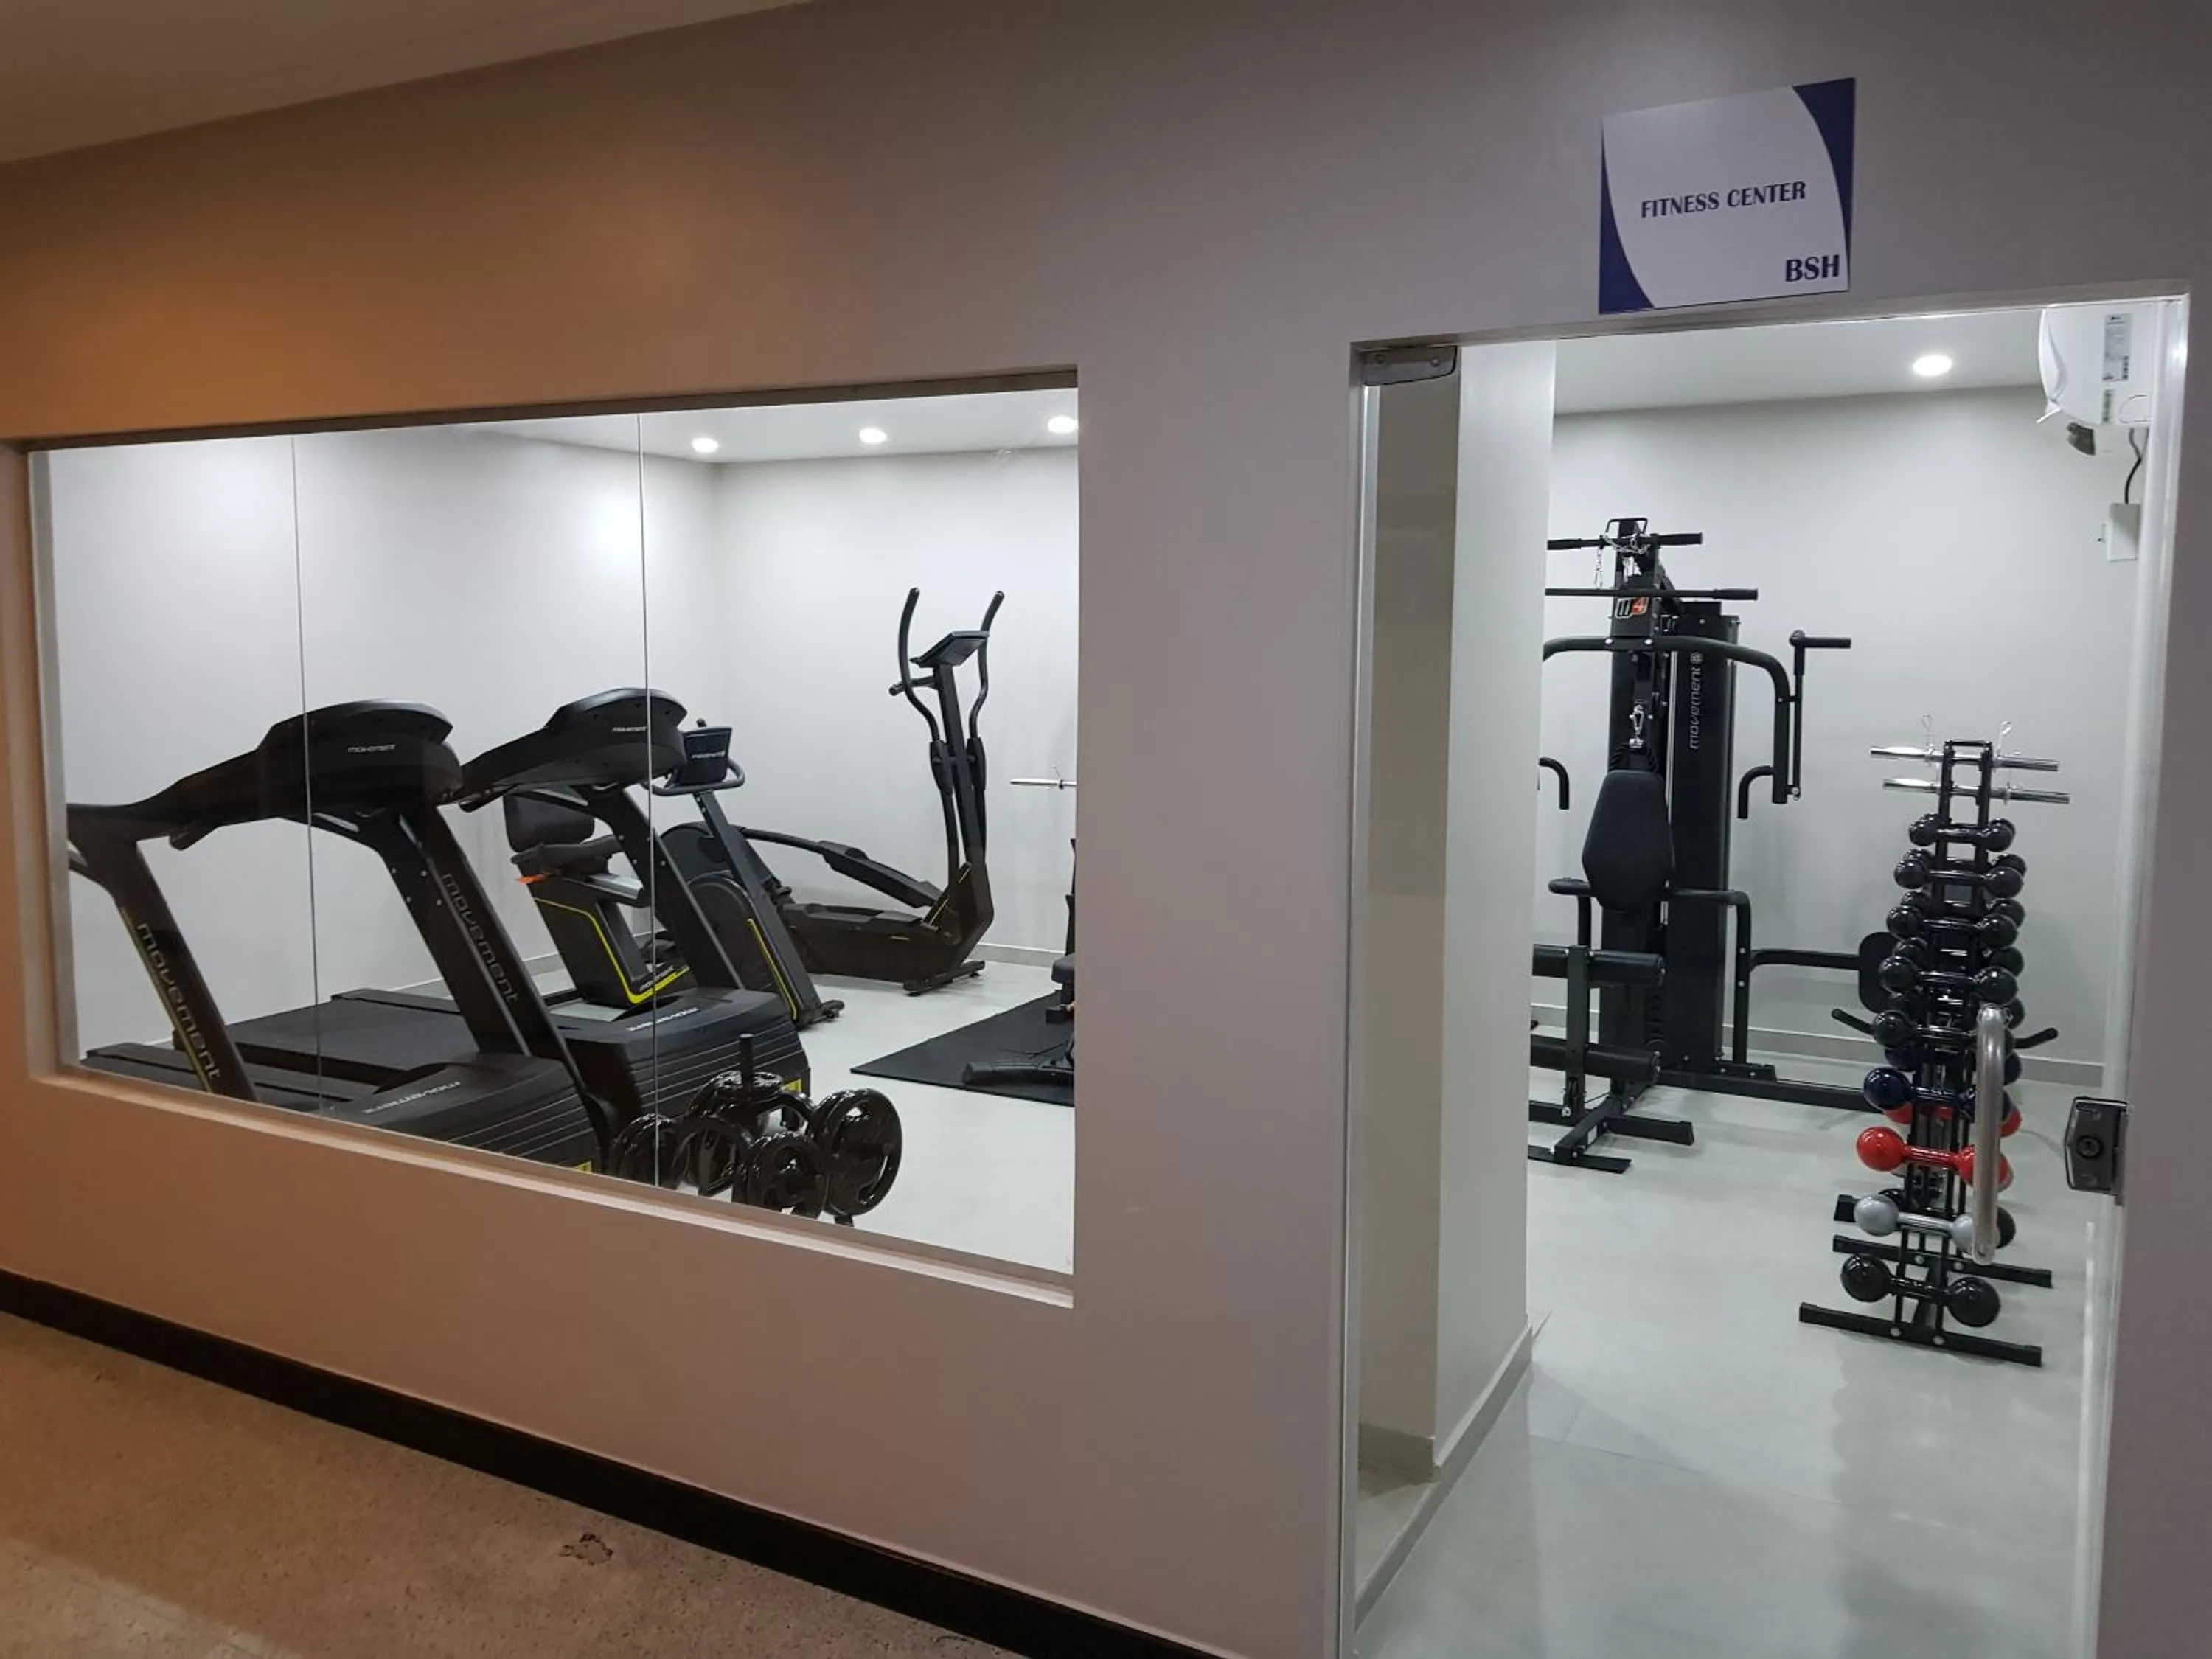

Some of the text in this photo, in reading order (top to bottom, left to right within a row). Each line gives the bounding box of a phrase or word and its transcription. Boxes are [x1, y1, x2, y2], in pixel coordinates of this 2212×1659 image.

[1641, 181, 1806, 218] FITNESS CENTER
[1784, 254, 1840, 282] BSH
[1689, 666, 1702, 750] movement
[442, 873, 518, 1004] movement
[136, 922, 220, 1080] movement
